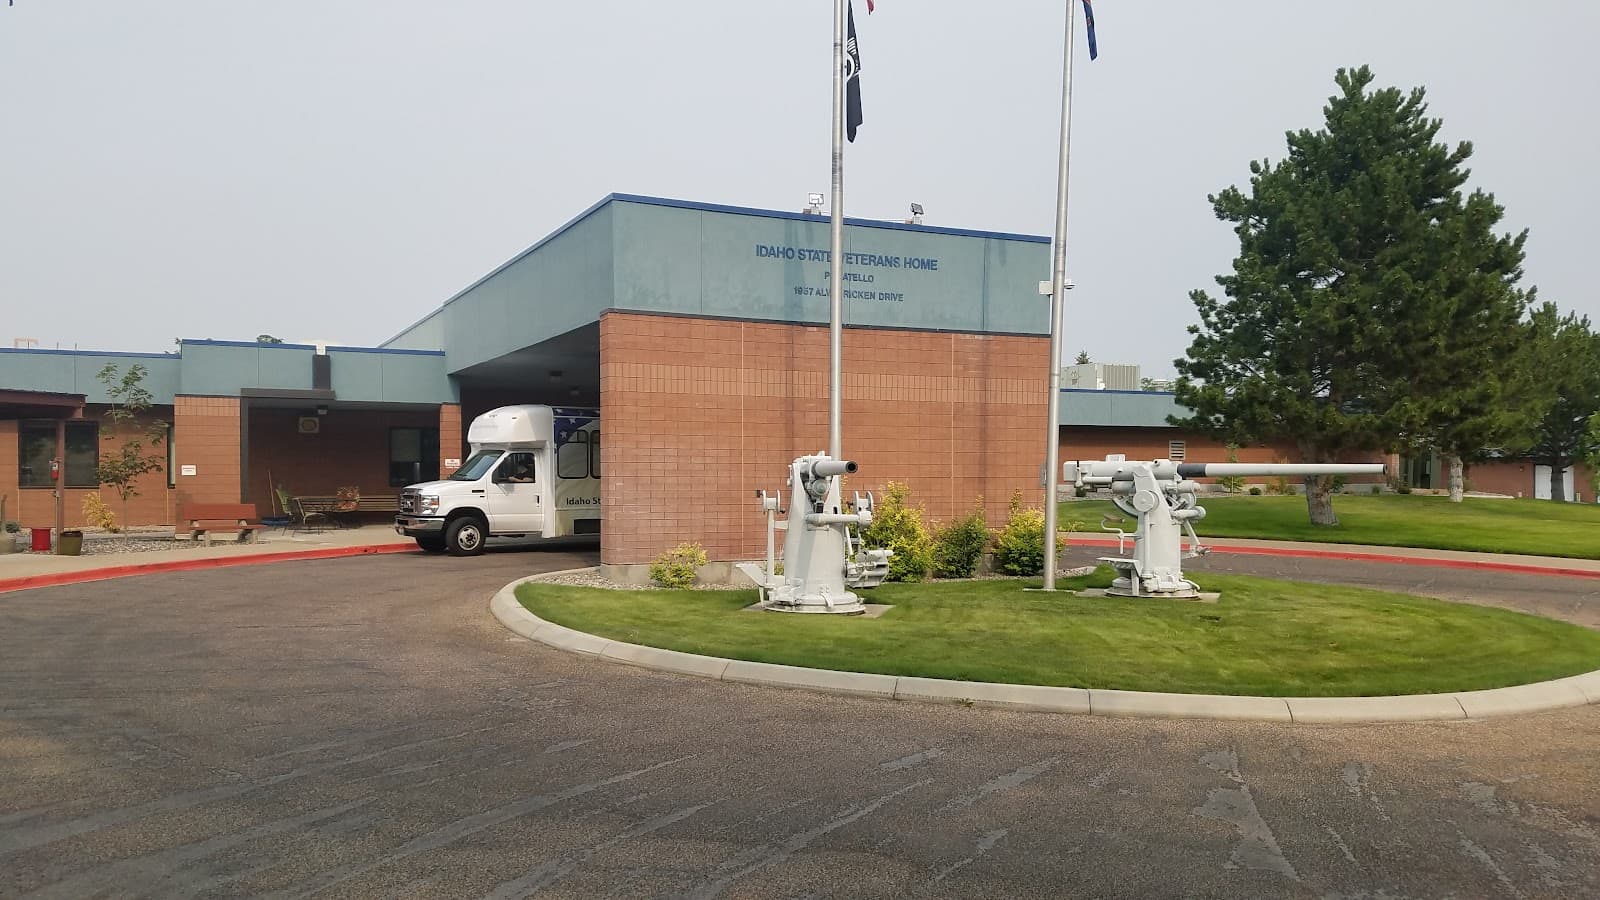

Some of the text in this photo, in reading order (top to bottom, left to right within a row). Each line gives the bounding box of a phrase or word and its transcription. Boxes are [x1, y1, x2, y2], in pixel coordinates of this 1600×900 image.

[756, 244, 795, 260] IDAHO
[903, 256, 938, 271] HOME
[824, 271, 874, 283] PATELLO
[878, 292, 904, 302] DRIVE
[566, 496, 591, 505] Idaho
